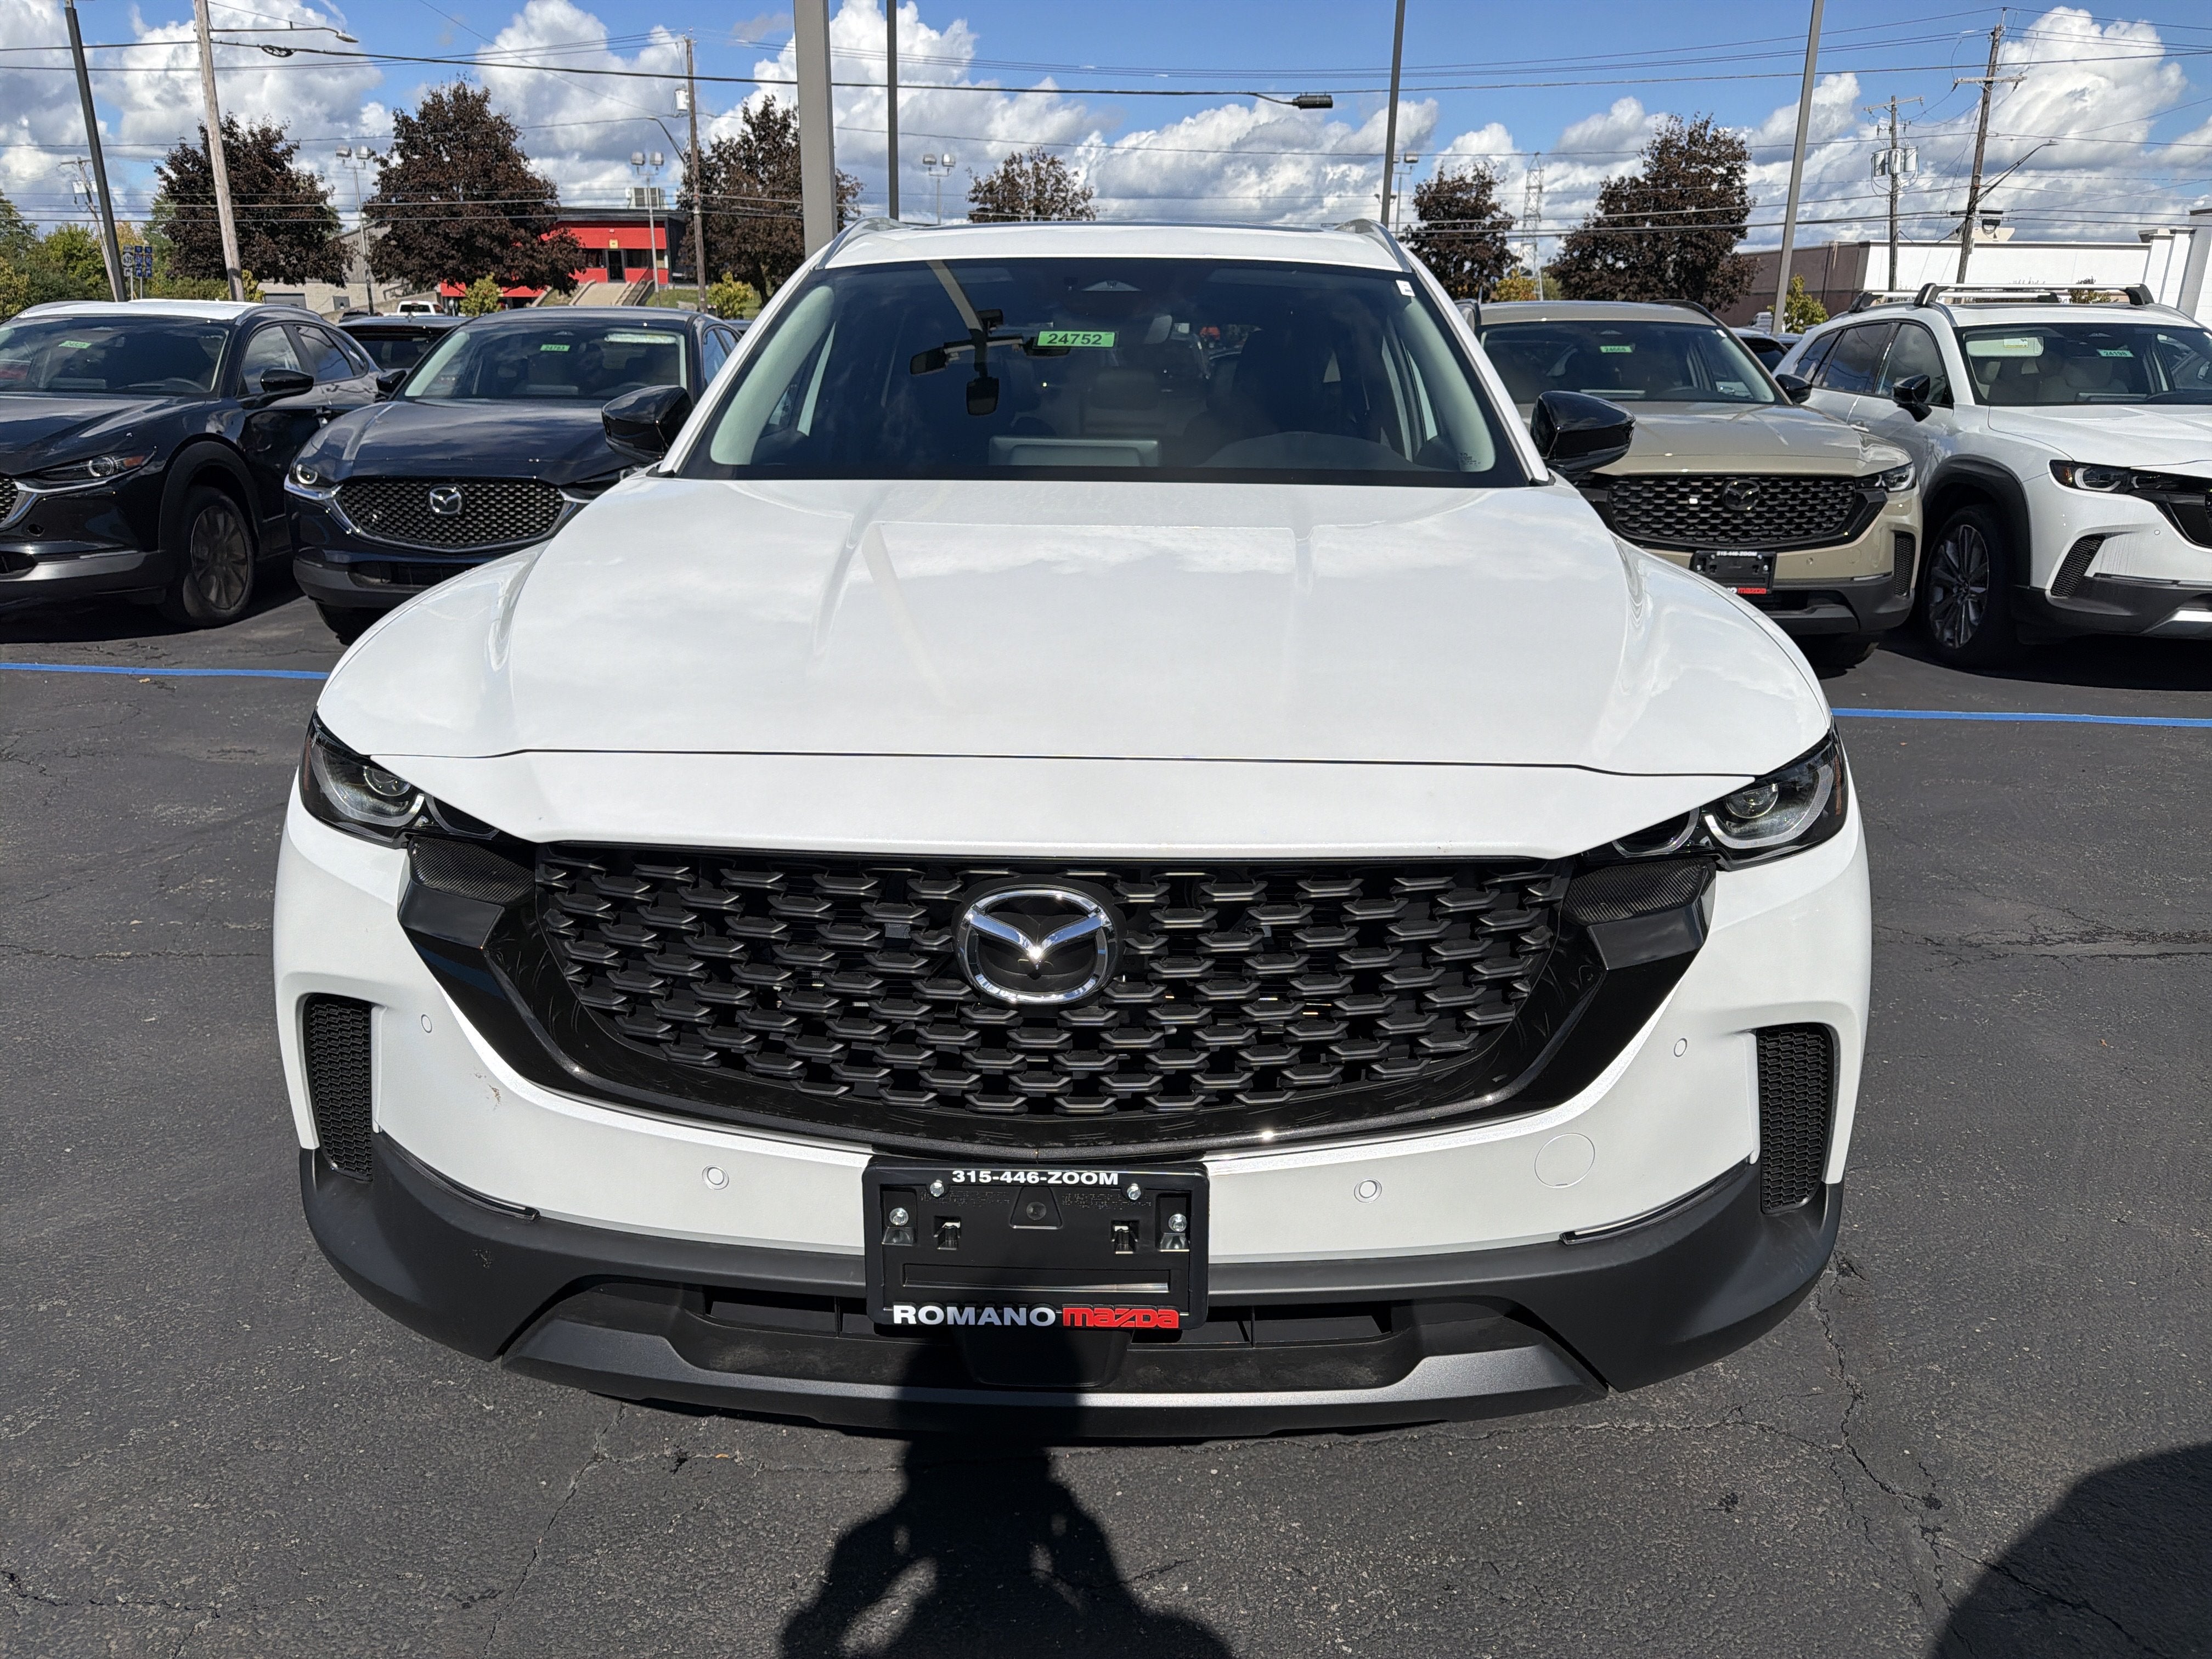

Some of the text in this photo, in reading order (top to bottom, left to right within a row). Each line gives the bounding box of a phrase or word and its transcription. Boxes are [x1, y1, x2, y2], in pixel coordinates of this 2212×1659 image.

[1047, 333, 1102, 345] 24752
[952, 1170, 1118, 1185] 315-446-ZOOM
[893, 1305, 1056, 1327] ROMANO
